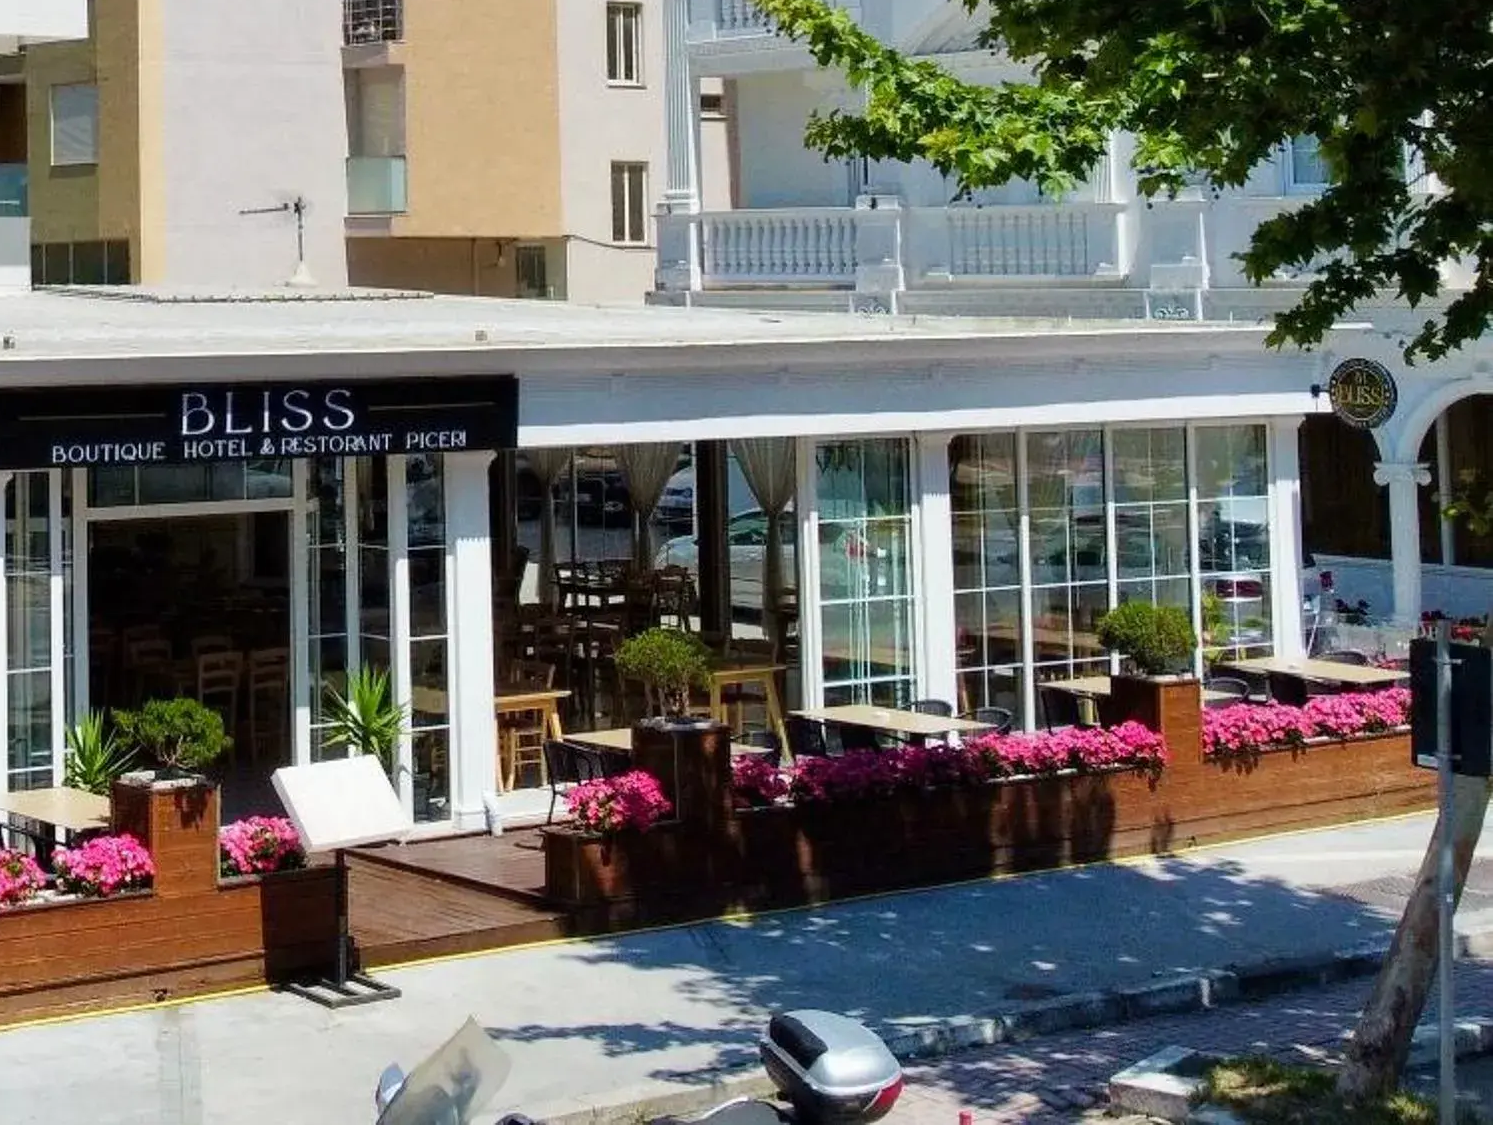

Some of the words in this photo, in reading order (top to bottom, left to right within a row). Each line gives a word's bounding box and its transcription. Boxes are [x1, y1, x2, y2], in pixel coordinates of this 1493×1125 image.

[181, 389, 355, 435] BLISS
[52, 442, 166, 463] BOUTIQUE
[184, 439, 253, 458] HOTEL
[260, 438, 275, 455] &
[281, 433, 392, 455] RESTORANT
[406, 430, 467, 449] PICERI
